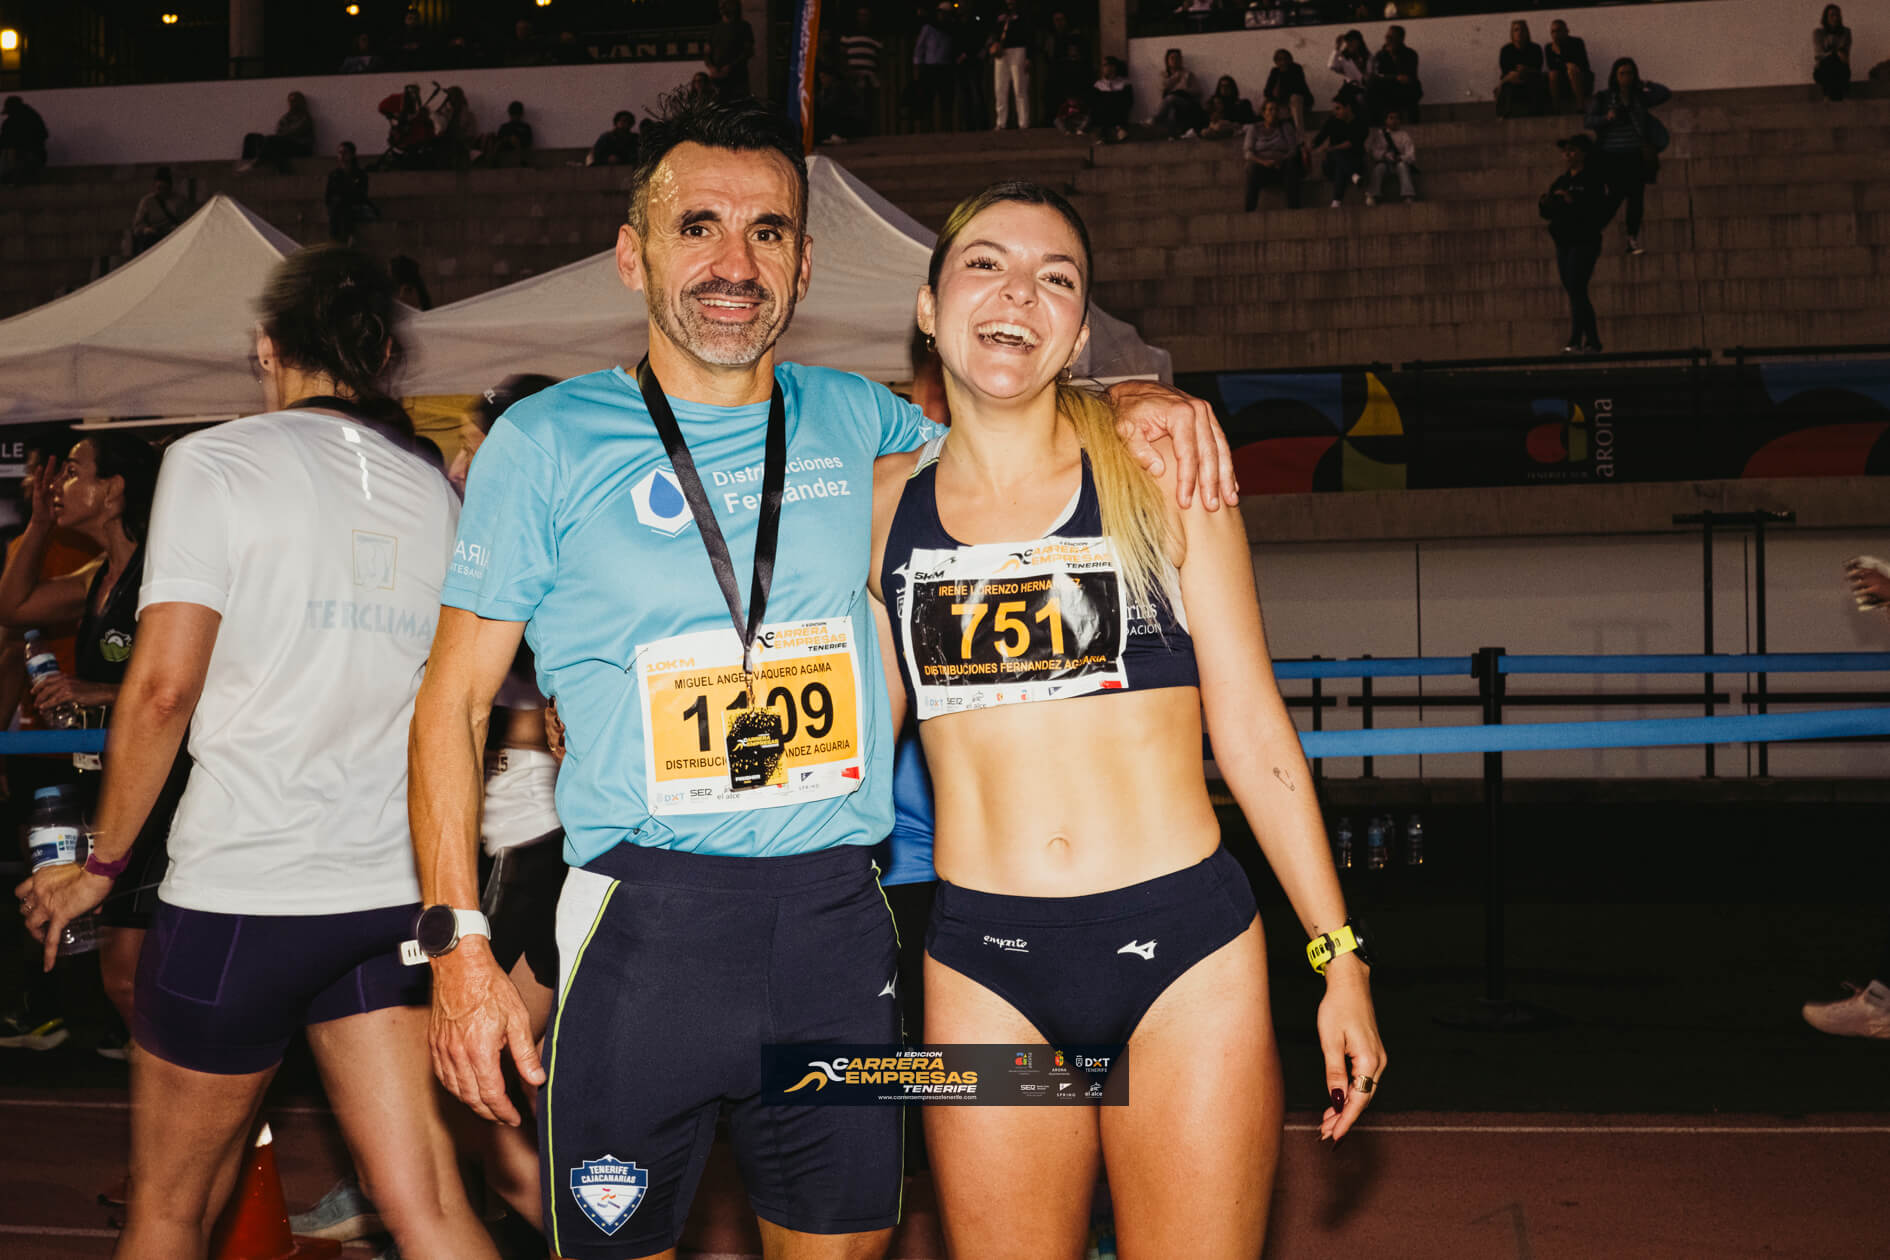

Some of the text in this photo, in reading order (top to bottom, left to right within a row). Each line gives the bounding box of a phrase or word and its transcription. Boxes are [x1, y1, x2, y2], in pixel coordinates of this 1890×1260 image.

[712, 455, 844, 487] Districiones
[723, 477, 851, 514] Feández
[938, 585, 968, 597] IRENE
[970, 583, 1019, 595] LRENZO
[307, 599, 434, 641] TERCLIMA
[765, 626, 828, 641] CARRERA
[951, 597, 1065, 660] 751
[1126, 623, 1162, 636] ACION
[773, 633, 848, 649] EMPRESAS
[808, 642, 848, 652] TENERIFE
[646, 657, 696, 673] 10KM
[924, 662, 998, 676] DISTRIBUCIONES
[1000, 659, 1061, 673] FERNANDEZ
[674, 676, 714, 689] MIGUEL
[754, 665, 798, 681] VAQUERO
[800, 662, 832, 676] AGAMA
[665, 755, 728, 770] DISTRIBUCI
[814, 738, 851, 755] AGUARIA
[689, 788, 713, 797] SER
[588, 1165, 629, 1175] TENERIFE
